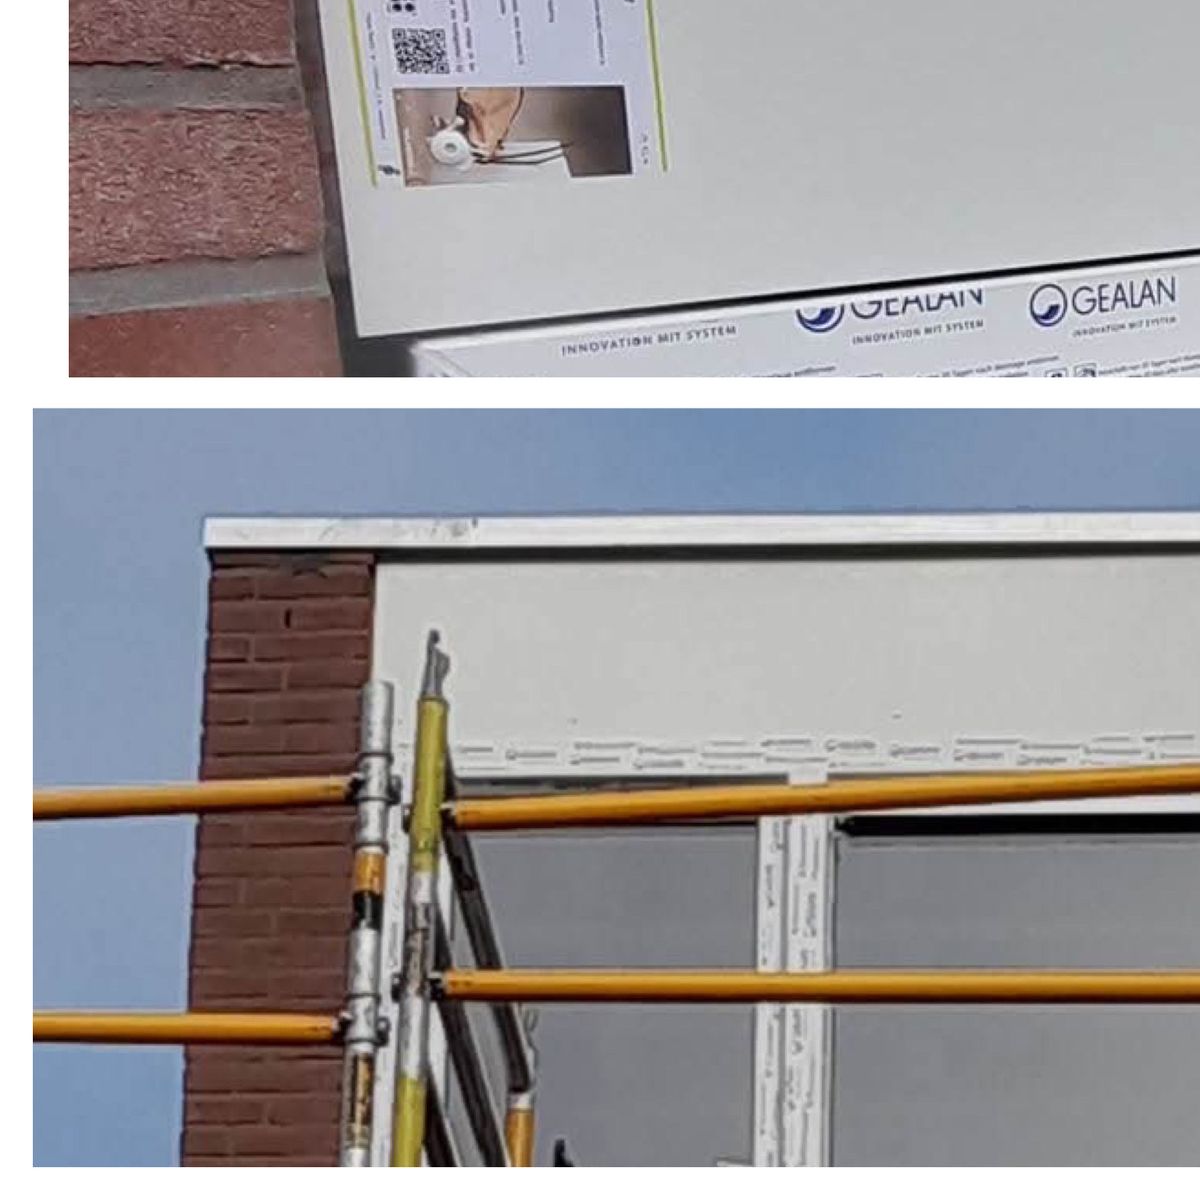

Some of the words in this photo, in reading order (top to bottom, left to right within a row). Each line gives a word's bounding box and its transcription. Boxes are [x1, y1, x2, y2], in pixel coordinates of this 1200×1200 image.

[1072, 276, 1176, 315] GEALAN
[562, 334, 653, 357] INNOVATION
[657, 331, 681, 344] MIT
[686, 325, 737, 341] SYSTEM
[852, 327, 921, 345] INNOVATION
[924, 322, 942, 334] MIT
[946, 319, 984, 333] SYSTEM
